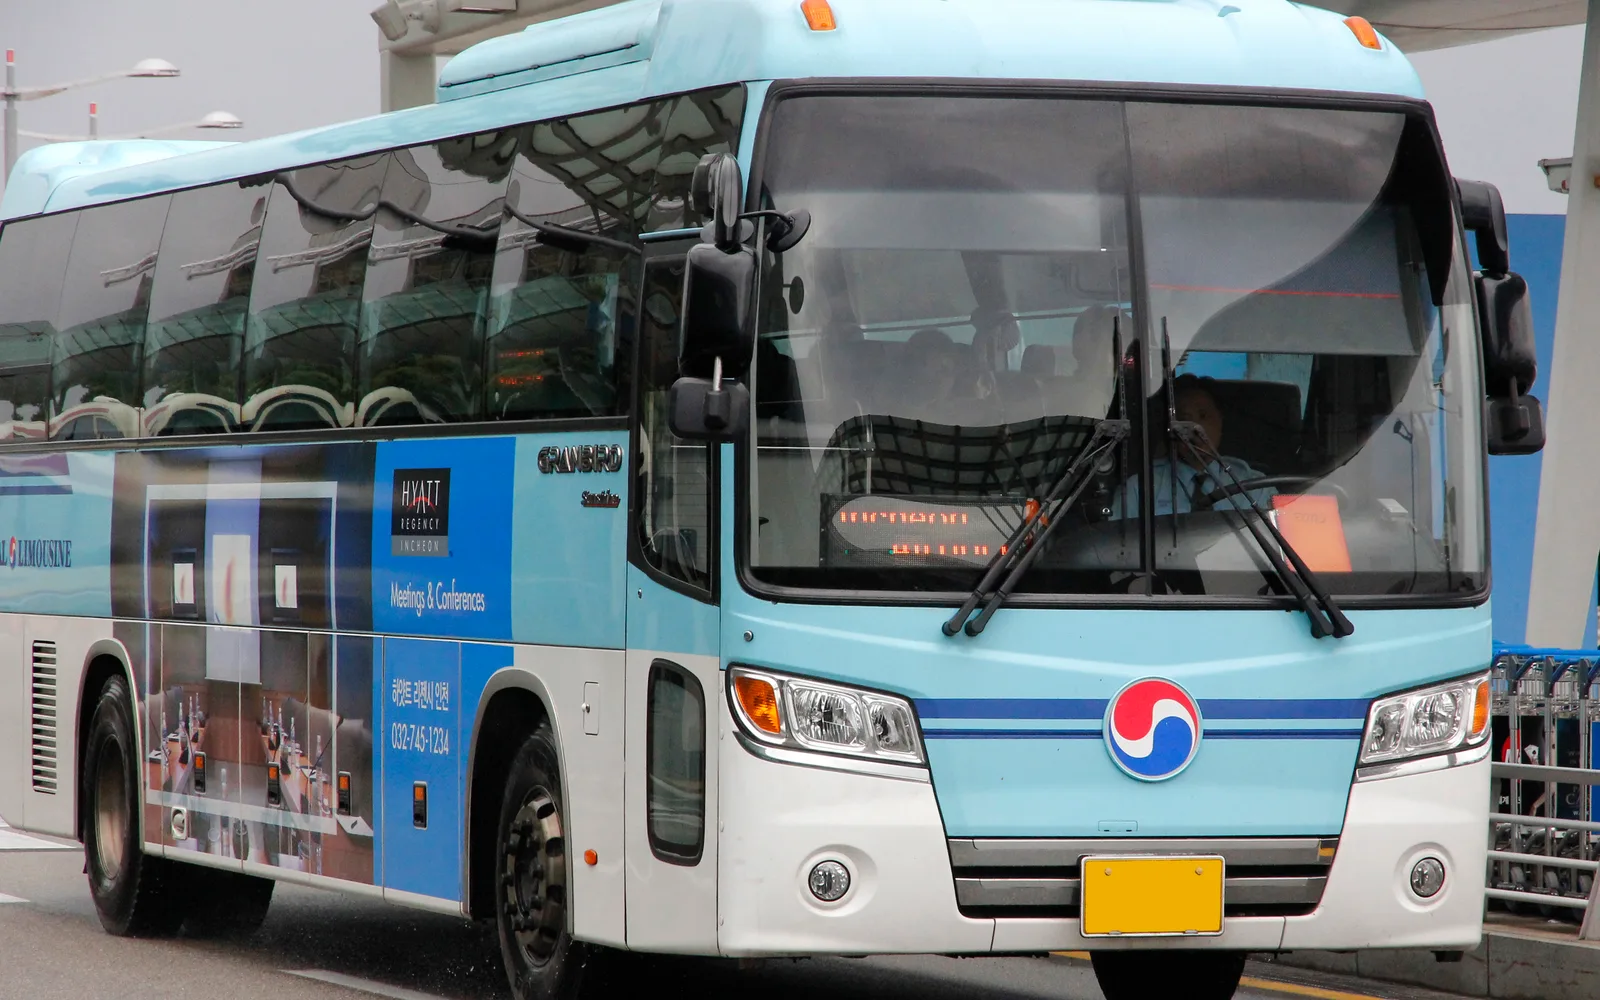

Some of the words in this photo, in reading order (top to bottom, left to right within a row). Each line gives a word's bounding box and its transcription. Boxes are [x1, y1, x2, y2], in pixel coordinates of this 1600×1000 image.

[537, 443, 623, 474] GRANBIRD
[401, 480, 440, 513] HYATT
[401, 518, 439, 530] REGENCY
[18, 539, 72, 567] LIMOUSINE
[400, 540, 439, 552] INCHEON
[390, 581, 425, 617] Meetings
[427, 581, 435, 609] &
[435, 578, 485, 612] Conferences
[392, 678, 412, 707] 하얏트
[435, 681, 449, 711] 인천
[391, 722, 449, 755] 032-745-1234
